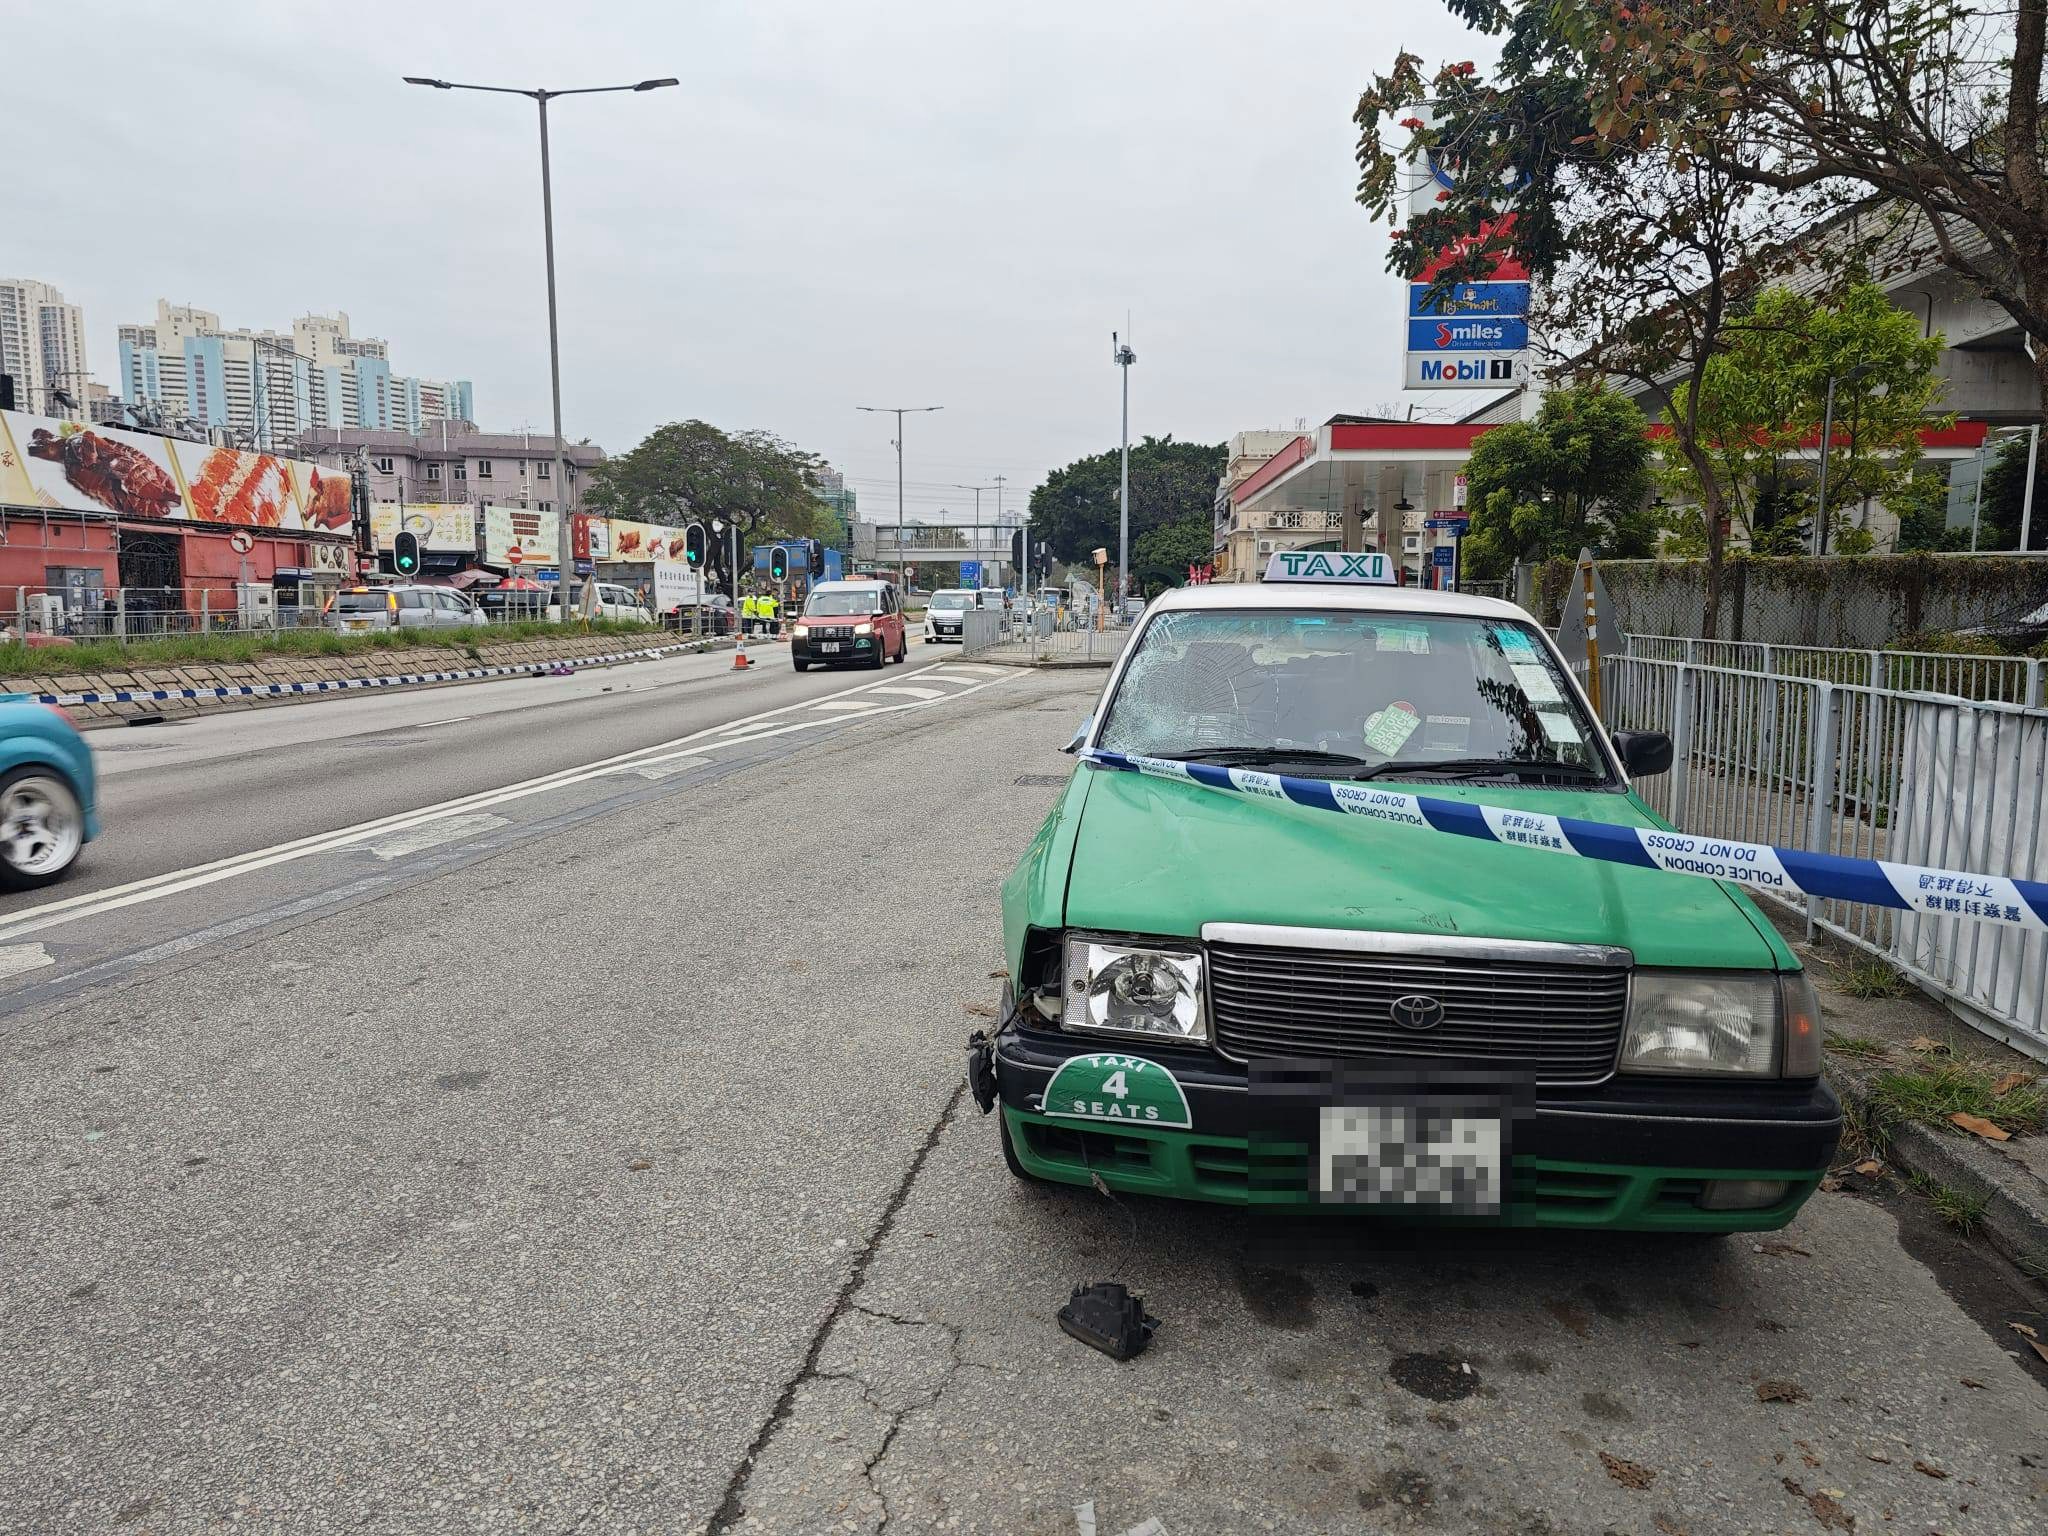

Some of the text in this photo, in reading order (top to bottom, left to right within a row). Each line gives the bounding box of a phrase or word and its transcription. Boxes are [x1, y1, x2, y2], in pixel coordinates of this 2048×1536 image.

[1434, 322, 1503, 348] Smiles
[1421, 360, 1486, 380] Mobil
[1280, 554, 1383, 578] TAXI
[1370, 724, 1387, 744] OUT
[1386, 711, 1399, 725] OF
[1378, 711, 1411, 752] SERVICE
[1336, 788, 1406, 808] DO NOT CROSS
[1387, 811, 1423, 826] POLICE
[1502, 814, 1546, 832] 不得越過
[1647, 834, 1757, 862] DO NOT CROSS
[1729, 865, 1783, 886] POLICE
[1919, 874, 1993, 898] 不得越過
[1087, 1056, 1147, 1073] TAXI
[1101, 1070, 1129, 1100] 4
[1073, 1100, 1160, 1120] SEATS
